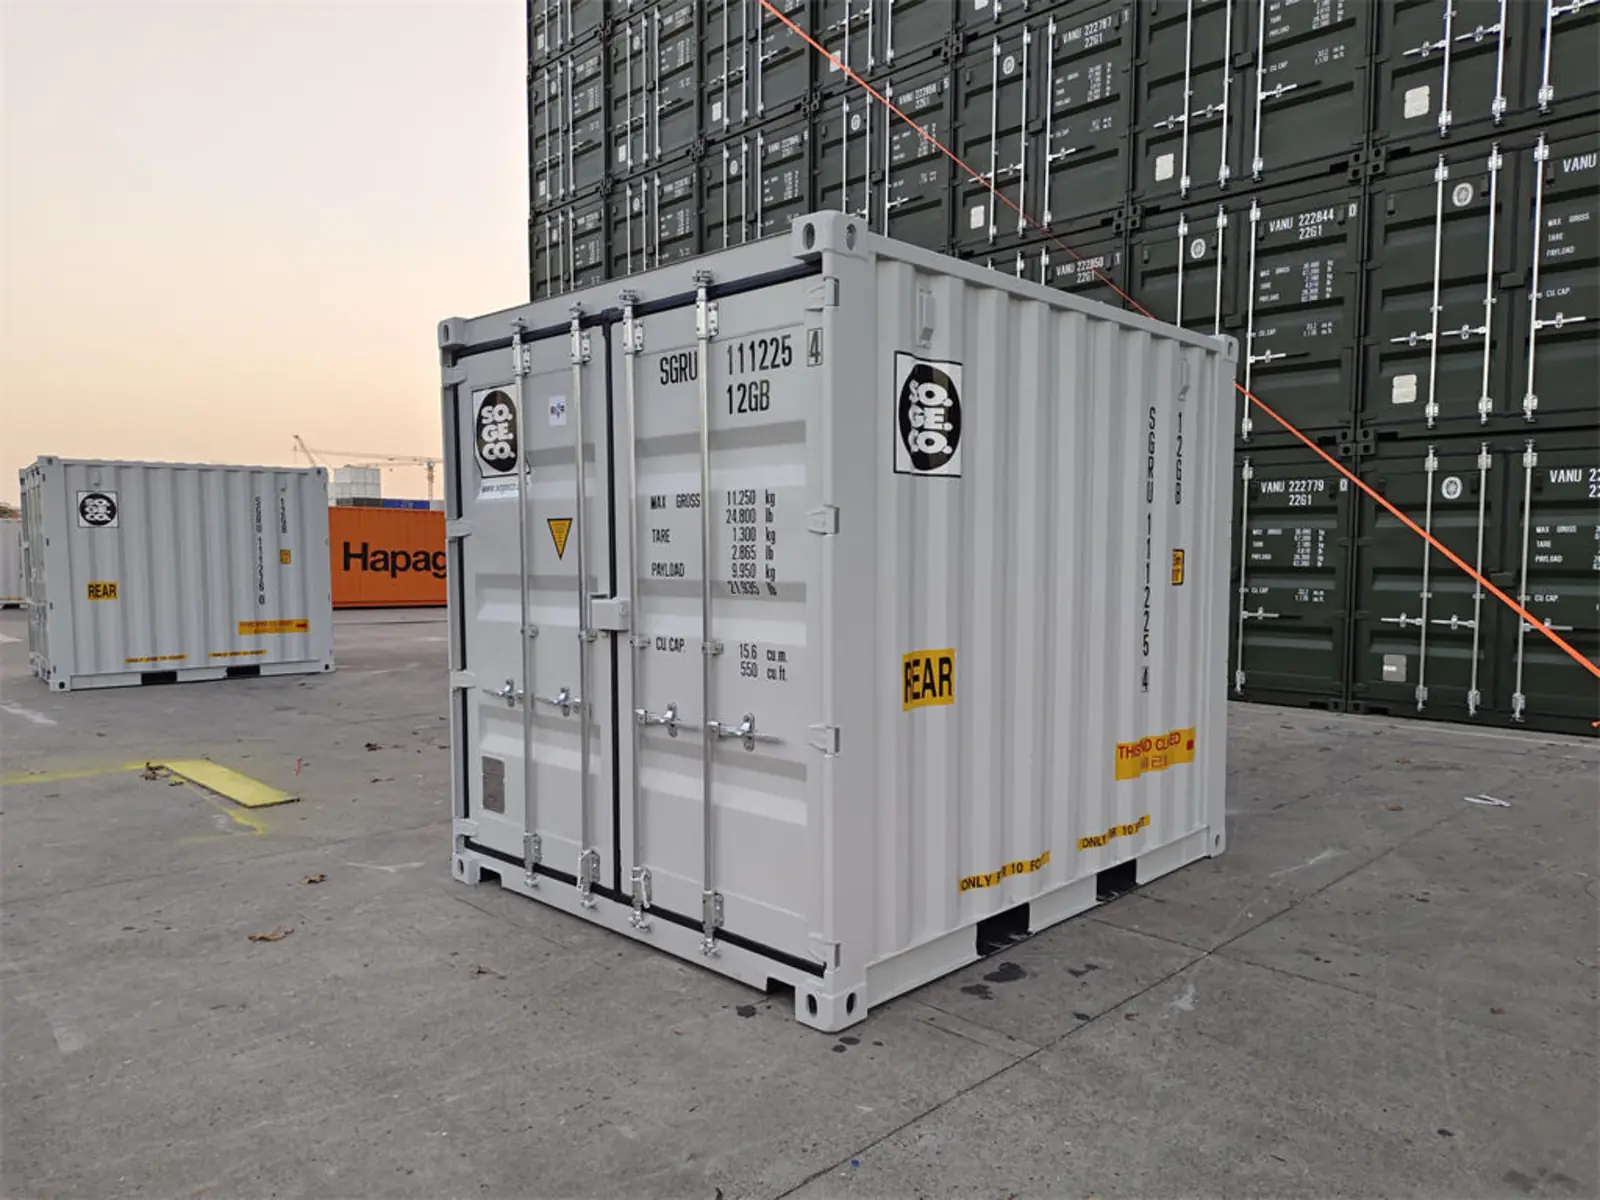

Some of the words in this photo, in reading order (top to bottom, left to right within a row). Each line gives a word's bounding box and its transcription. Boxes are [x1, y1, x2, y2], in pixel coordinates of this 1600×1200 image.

[1563, 153, 1597, 173] VANU
[1269, 216, 1294, 233] VANU
[1298, 208, 1335, 227] 222844
[1298, 224, 1323, 240] 22G1
[659, 350, 699, 386] SGRU
[727, 333, 793, 376] 111225
[809, 330, 822, 364] 4
[726, 379, 771, 415] 12GB
[1146, 406, 1156, 504] SGRU
[1261, 480, 1285, 493] VANU
[1288, 479, 1325, 492] 222779
[1550, 469, 1582, 483] VANU
[650, 495, 666, 509] MAX
[675, 492, 701, 508] GROSS
[726, 489, 757, 507] 11.250
[765, 489, 776, 508] kg
[725, 507, 757, 524] 24.800
[765, 507, 774, 523] lb
[652, 528, 671, 543] TARE
[733, 526, 757, 542] 1.300
[765, 526, 776, 545] kg
[343, 541, 447, 579] Hapag
[731, 544, 757, 560] 2.865
[765, 544, 774, 560] lb
[651, 562, 685, 578] PAYLOAD
[731, 562, 757, 579] 9.950
[765, 563, 776, 582] kg
[88, 583, 117, 599] REAR
[1143, 511, 1151, 657] 111225
[656, 636, 667, 651] CU
[740, 661, 759, 678] 550
[904, 656, 953, 704] REAR
[1081, 835, 1107, 849] ONLY
[960, 874, 992, 892] ONLY
[1011, 861, 1024, 875] 10
